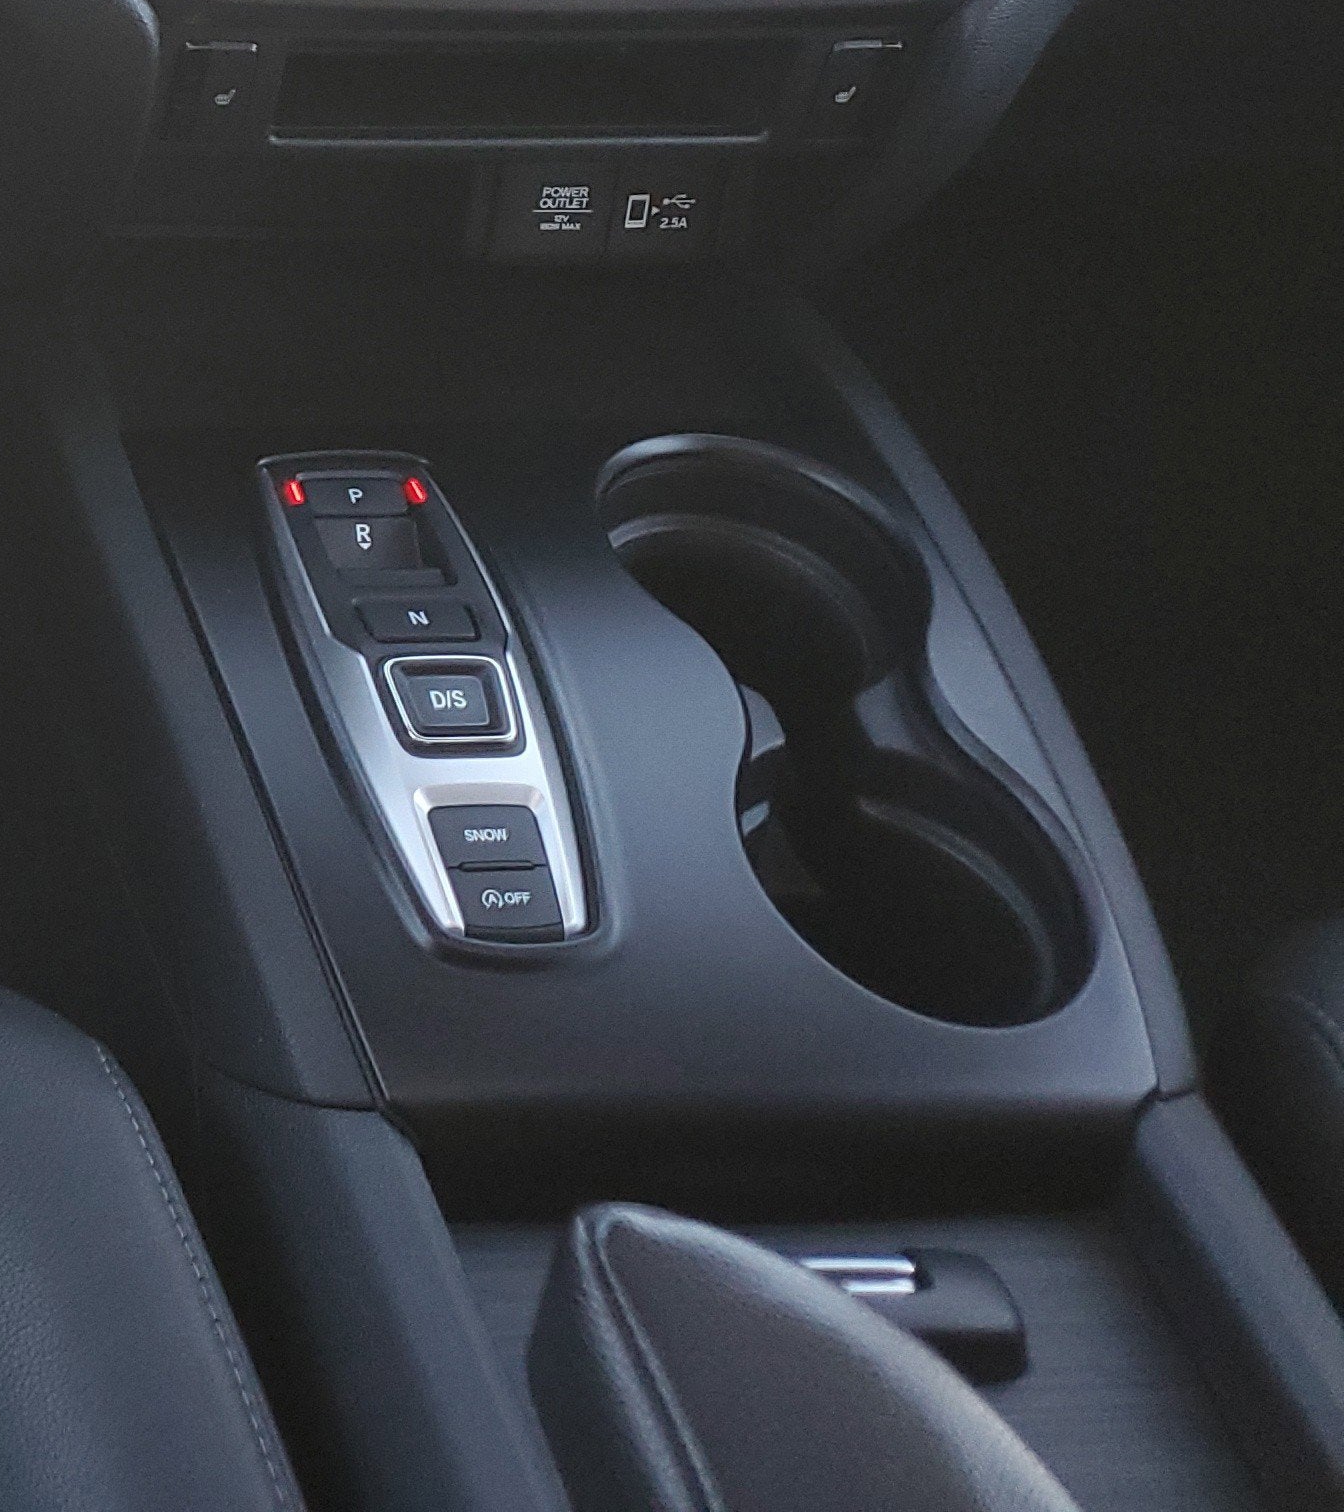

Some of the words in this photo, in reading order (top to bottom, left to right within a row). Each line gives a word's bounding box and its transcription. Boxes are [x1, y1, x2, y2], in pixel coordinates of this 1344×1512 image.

[542, 187, 589, 198] POWER
[539, 198, 589, 209] OUTLET
[660, 217, 688, 229] 2.5A
[348, 488, 364, 504] P
[355, 524, 372, 543] R
[408, 610, 430, 626] N
[430, 690, 467, 709] D/S
[464, 829, 508, 843] SNOW
[504, 891, 531, 906] OFF
